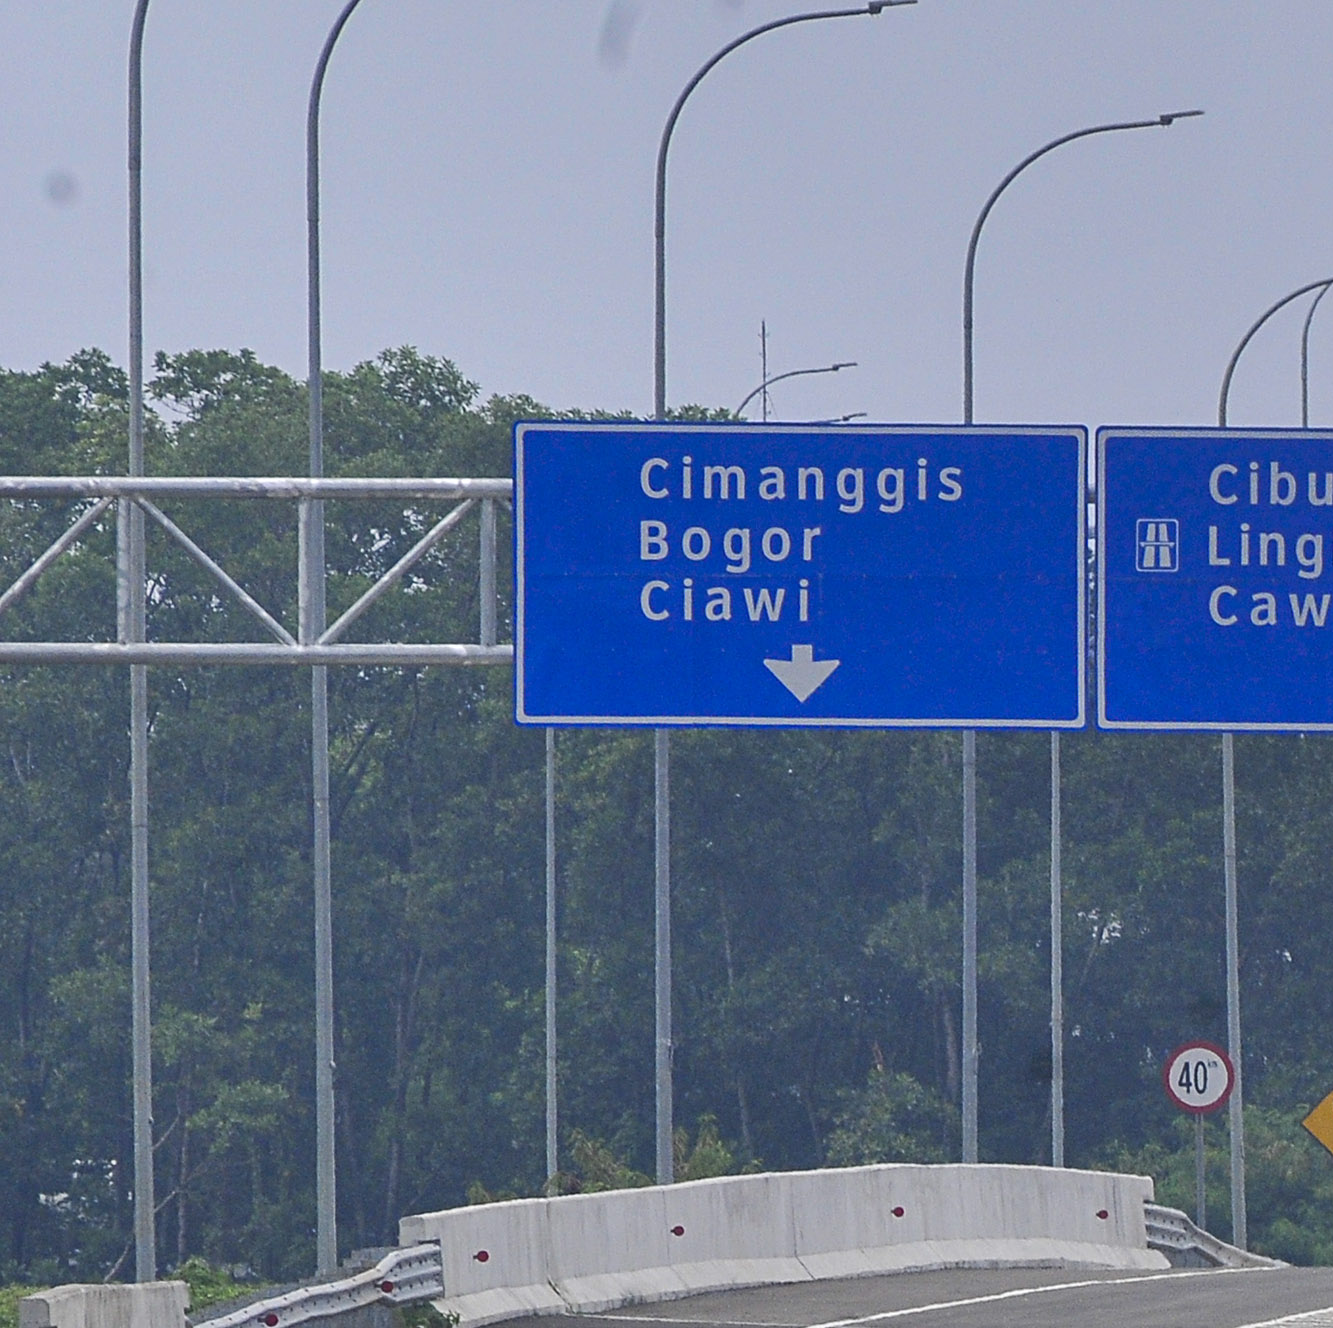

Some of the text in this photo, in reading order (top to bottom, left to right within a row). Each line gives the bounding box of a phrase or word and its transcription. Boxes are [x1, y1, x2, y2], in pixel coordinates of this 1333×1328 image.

[640, 455, 964, 514] Cimanggis
[640, 520, 822, 574] Bogor
[640, 577, 810, 622] Ciawi
[1178, 1061, 1208, 1095] 40
